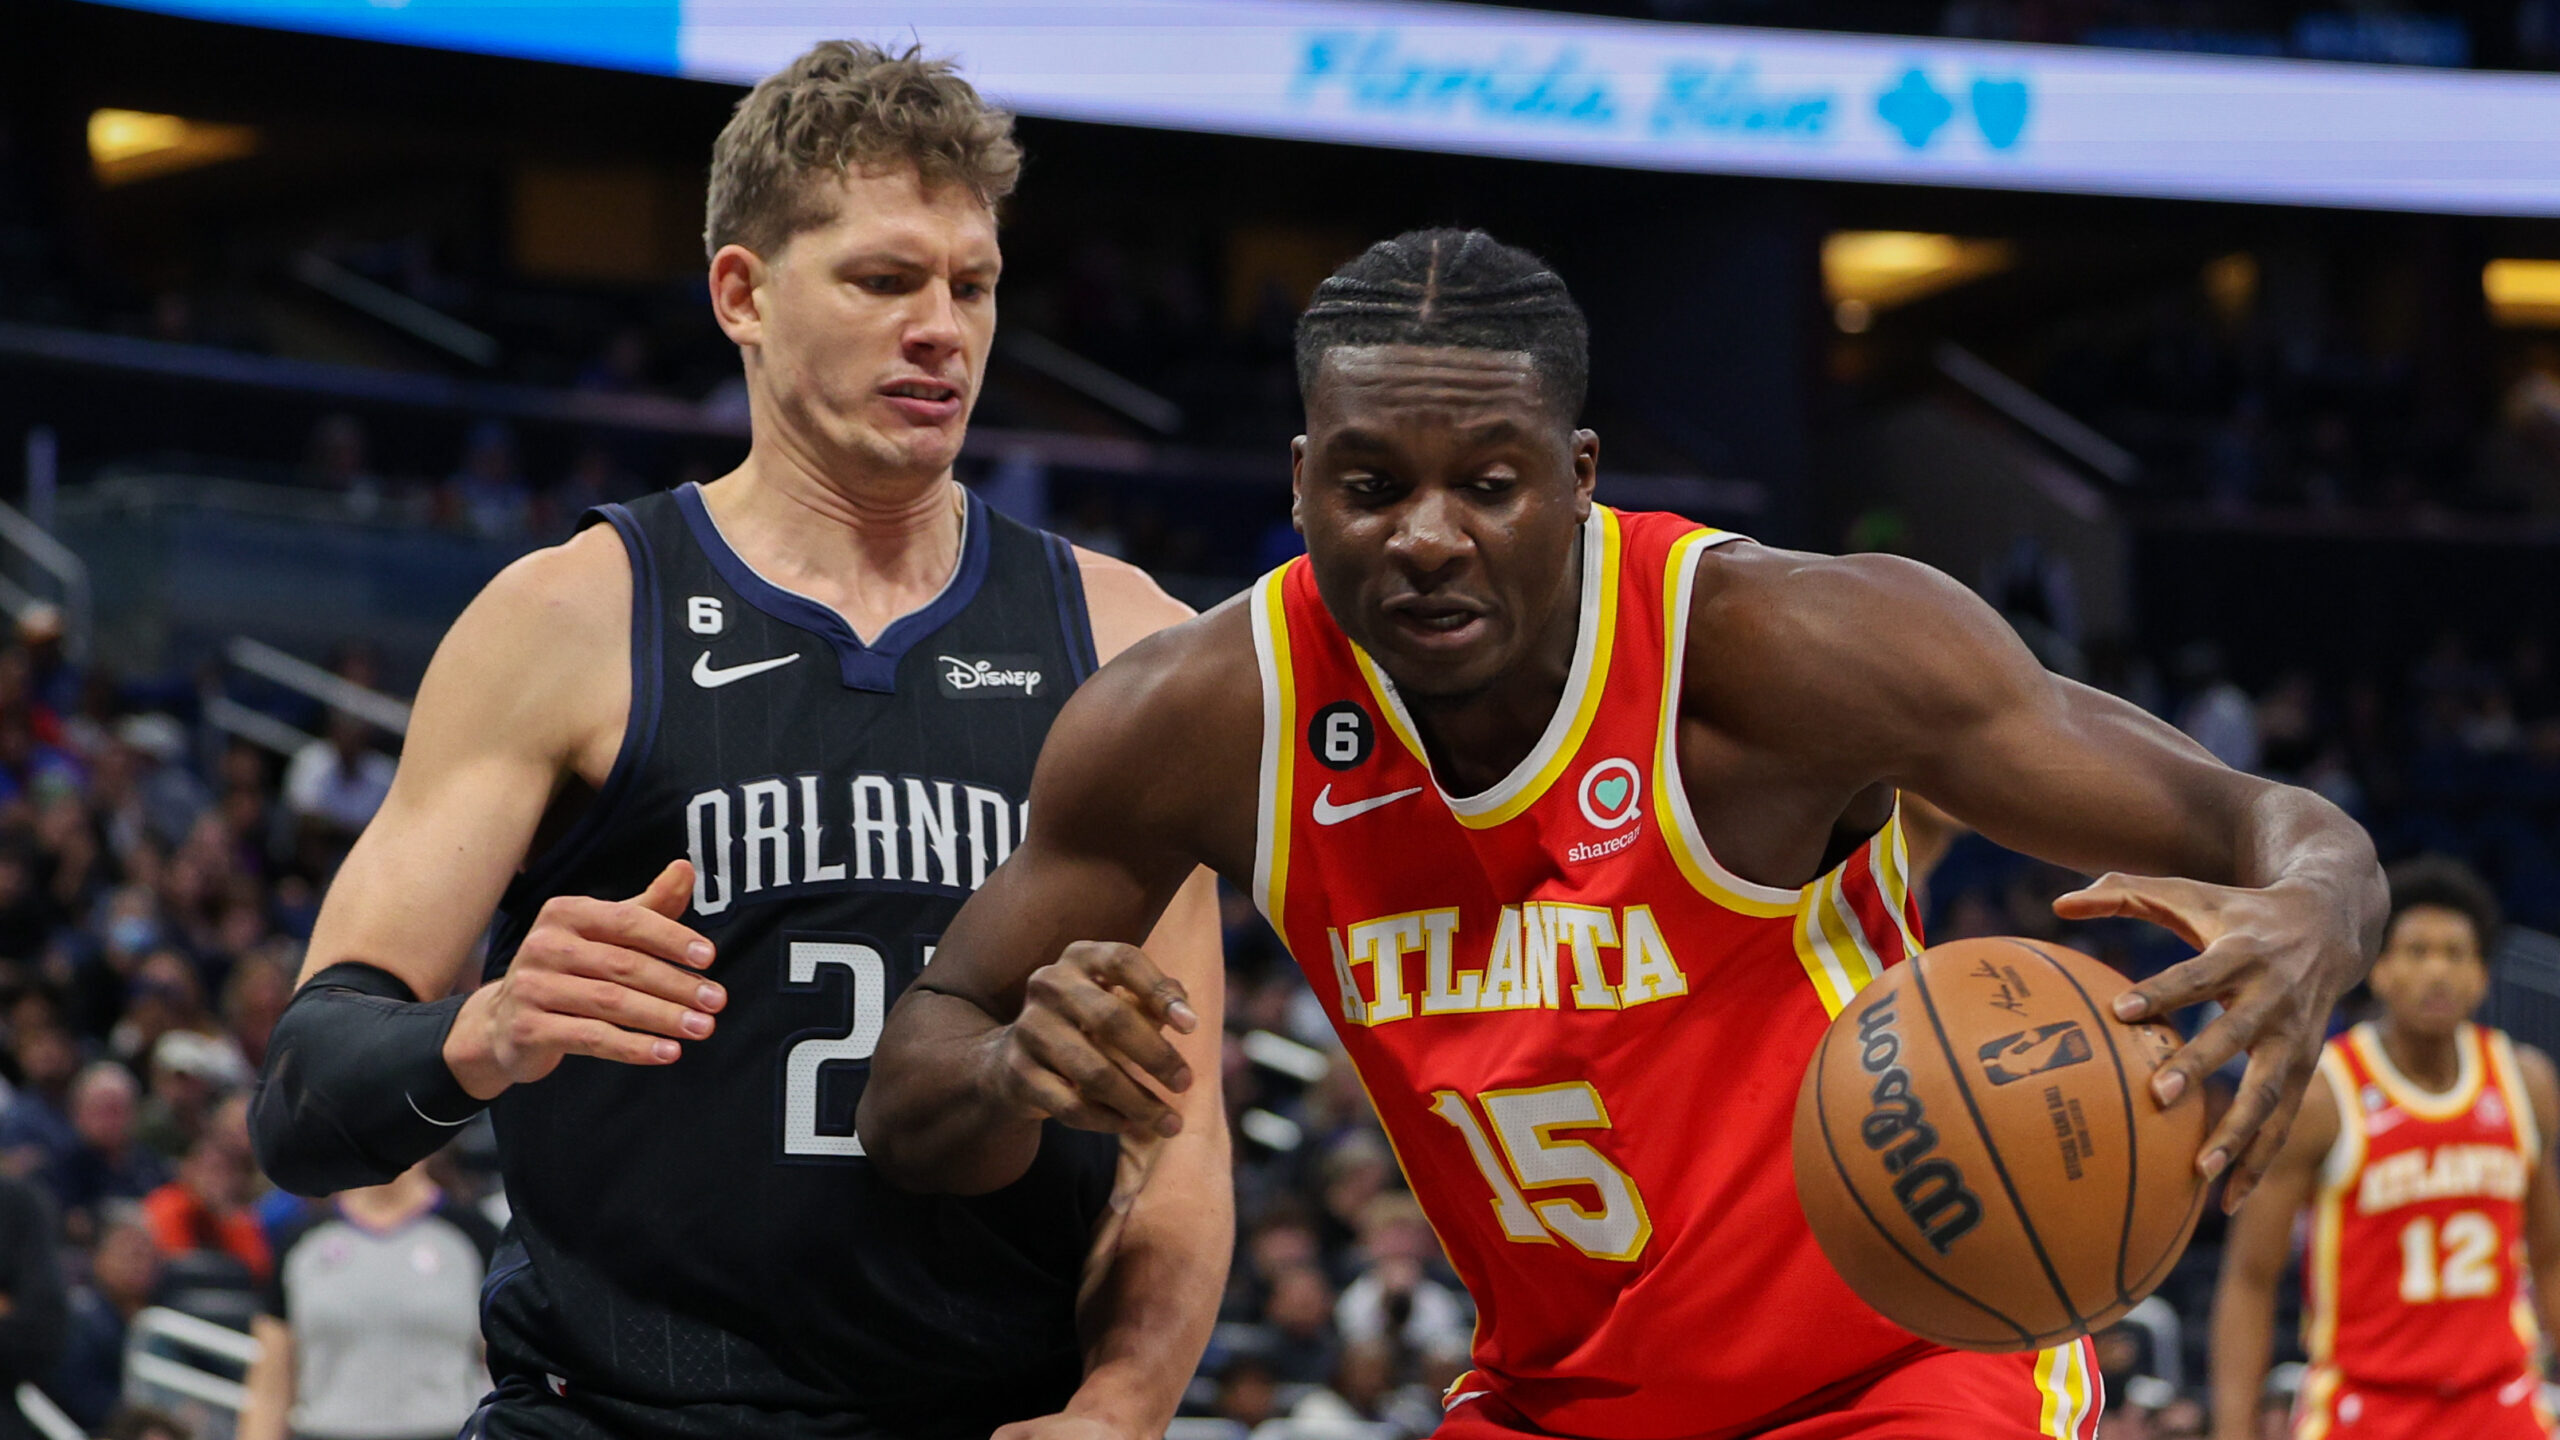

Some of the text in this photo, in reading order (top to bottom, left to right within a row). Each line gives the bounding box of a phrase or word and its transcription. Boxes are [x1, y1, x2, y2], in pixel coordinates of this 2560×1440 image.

[687, 595, 724, 635] 6
[938, 655, 1042, 695] Disney
[1325, 712, 1360, 762] 6
[685, 774, 1030, 917] ORLAND
[1325, 900, 1689, 1027] ATLANTA
[1856, 989, 1984, 1257] Wilson
[1428, 1080, 1653, 1263] 15
[2356, 1144, 2528, 1216] ATLANTA
[2400, 1208, 2500, 1303] 12
